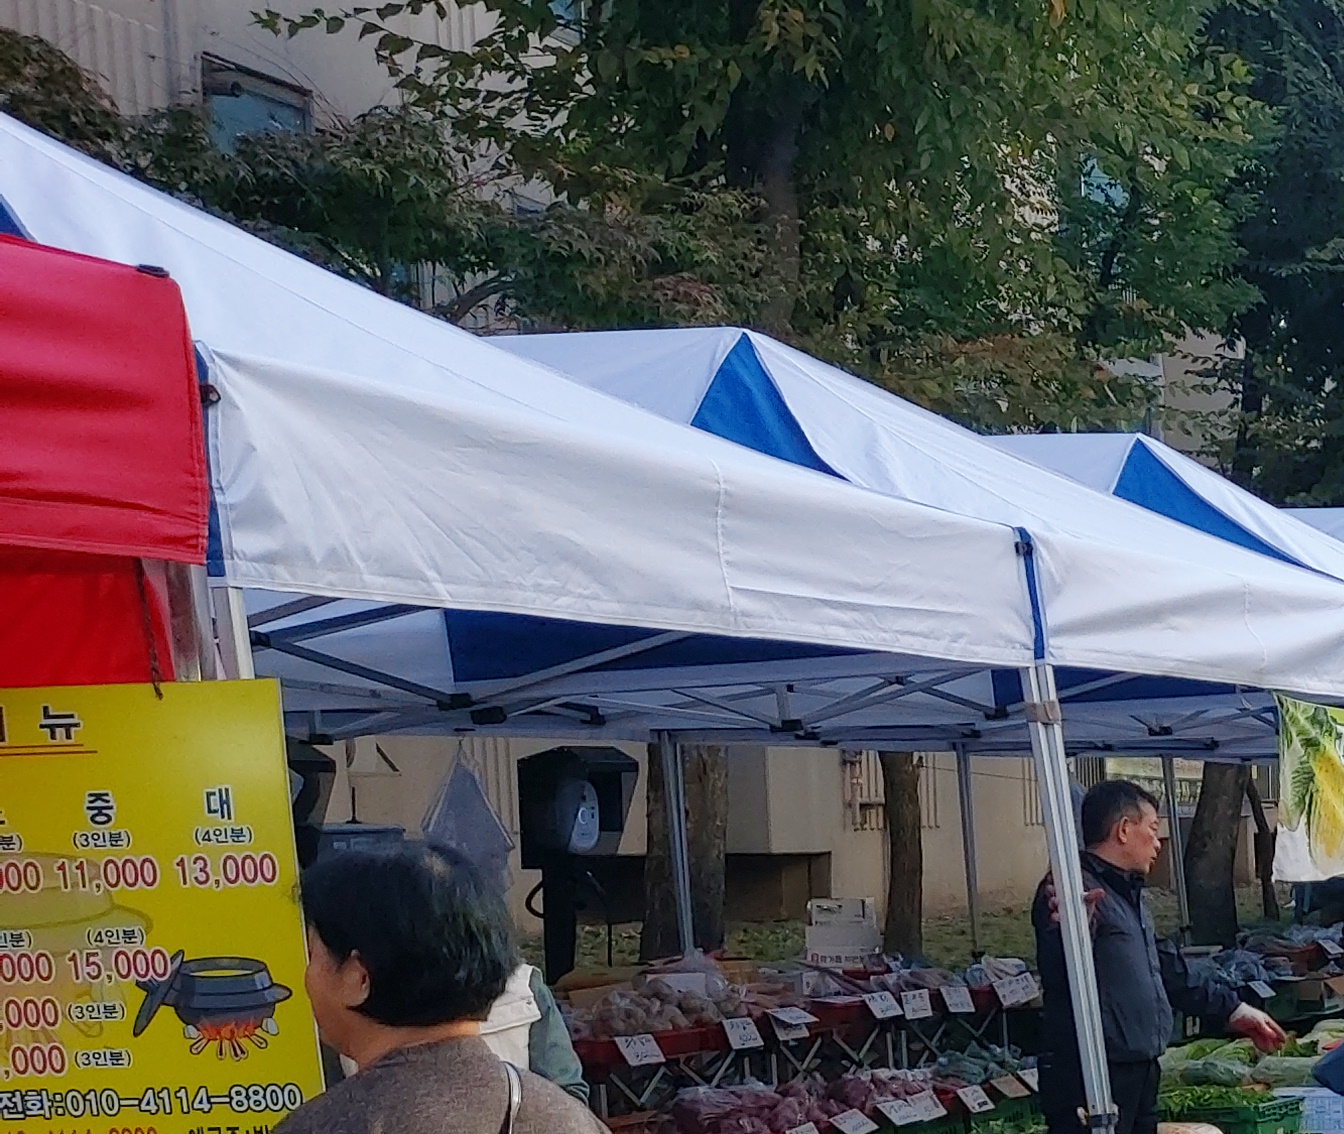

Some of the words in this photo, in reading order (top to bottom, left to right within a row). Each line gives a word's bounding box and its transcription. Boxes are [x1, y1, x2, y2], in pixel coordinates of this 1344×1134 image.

[86, 791, 115, 826] 중
[205, 787, 233, 821] 대
[73, 831, 131, 850] (3인분)
[194, 826, 253, 845] (4인분)
[56, 858, 158, 893] 11,000
[175, 853, 278, 889] 13,000
[87, 928, 145, 946] (4인분)
[68, 949, 170, 983] 15,000
[68, 1003, 125, 1021] (3인분)
[75, 1050, 132, 1068] (3인분)
